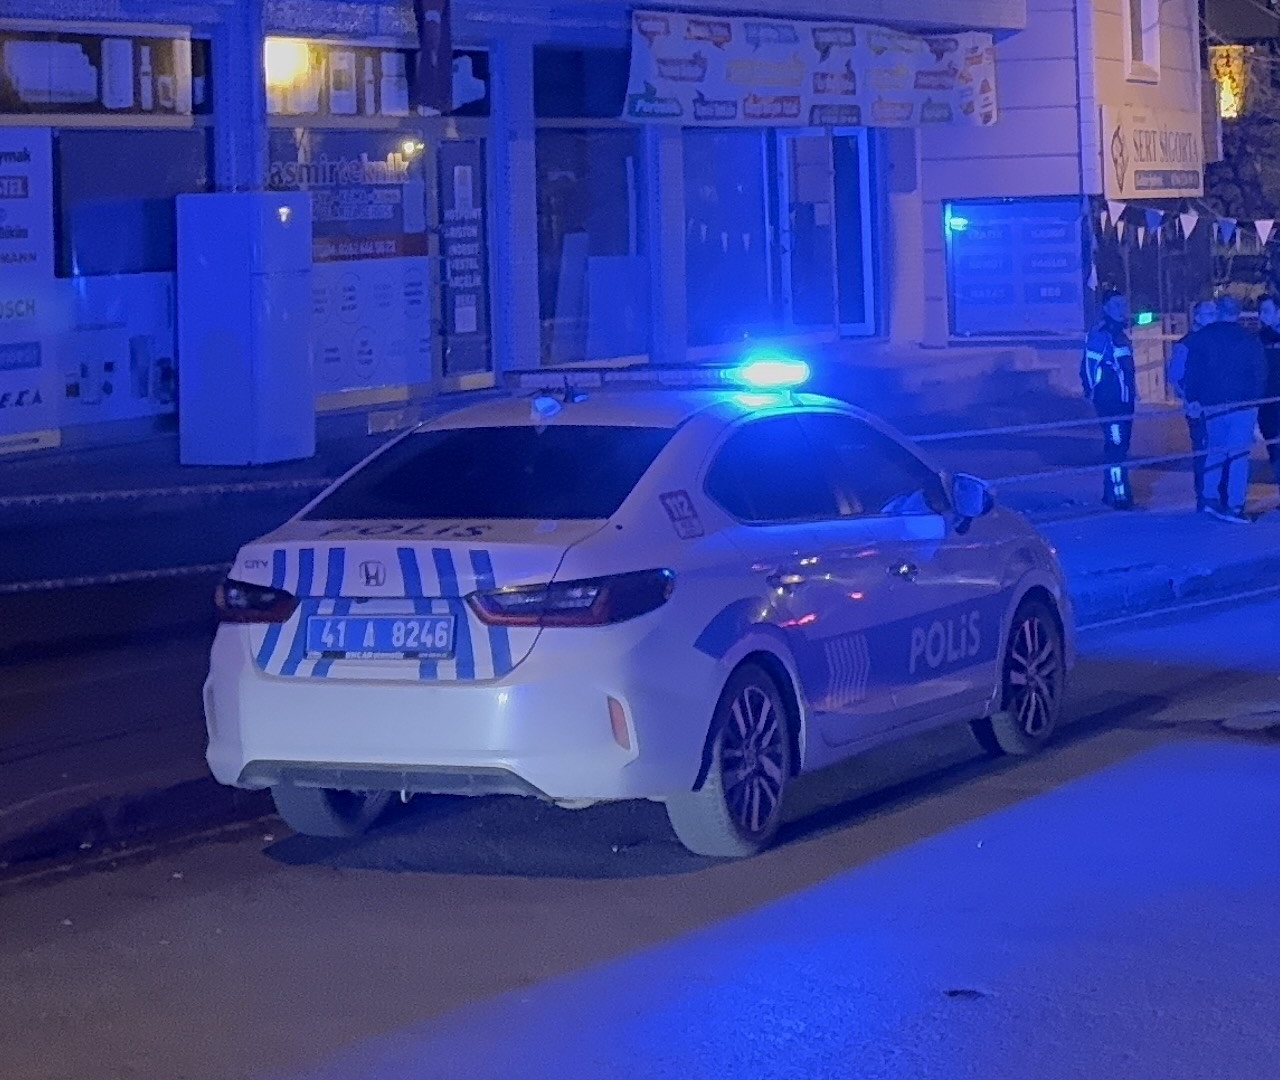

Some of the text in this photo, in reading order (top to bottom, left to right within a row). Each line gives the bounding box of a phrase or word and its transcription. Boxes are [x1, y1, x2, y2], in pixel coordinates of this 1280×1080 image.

[321, 620, 450, 649] 41 A 8246
